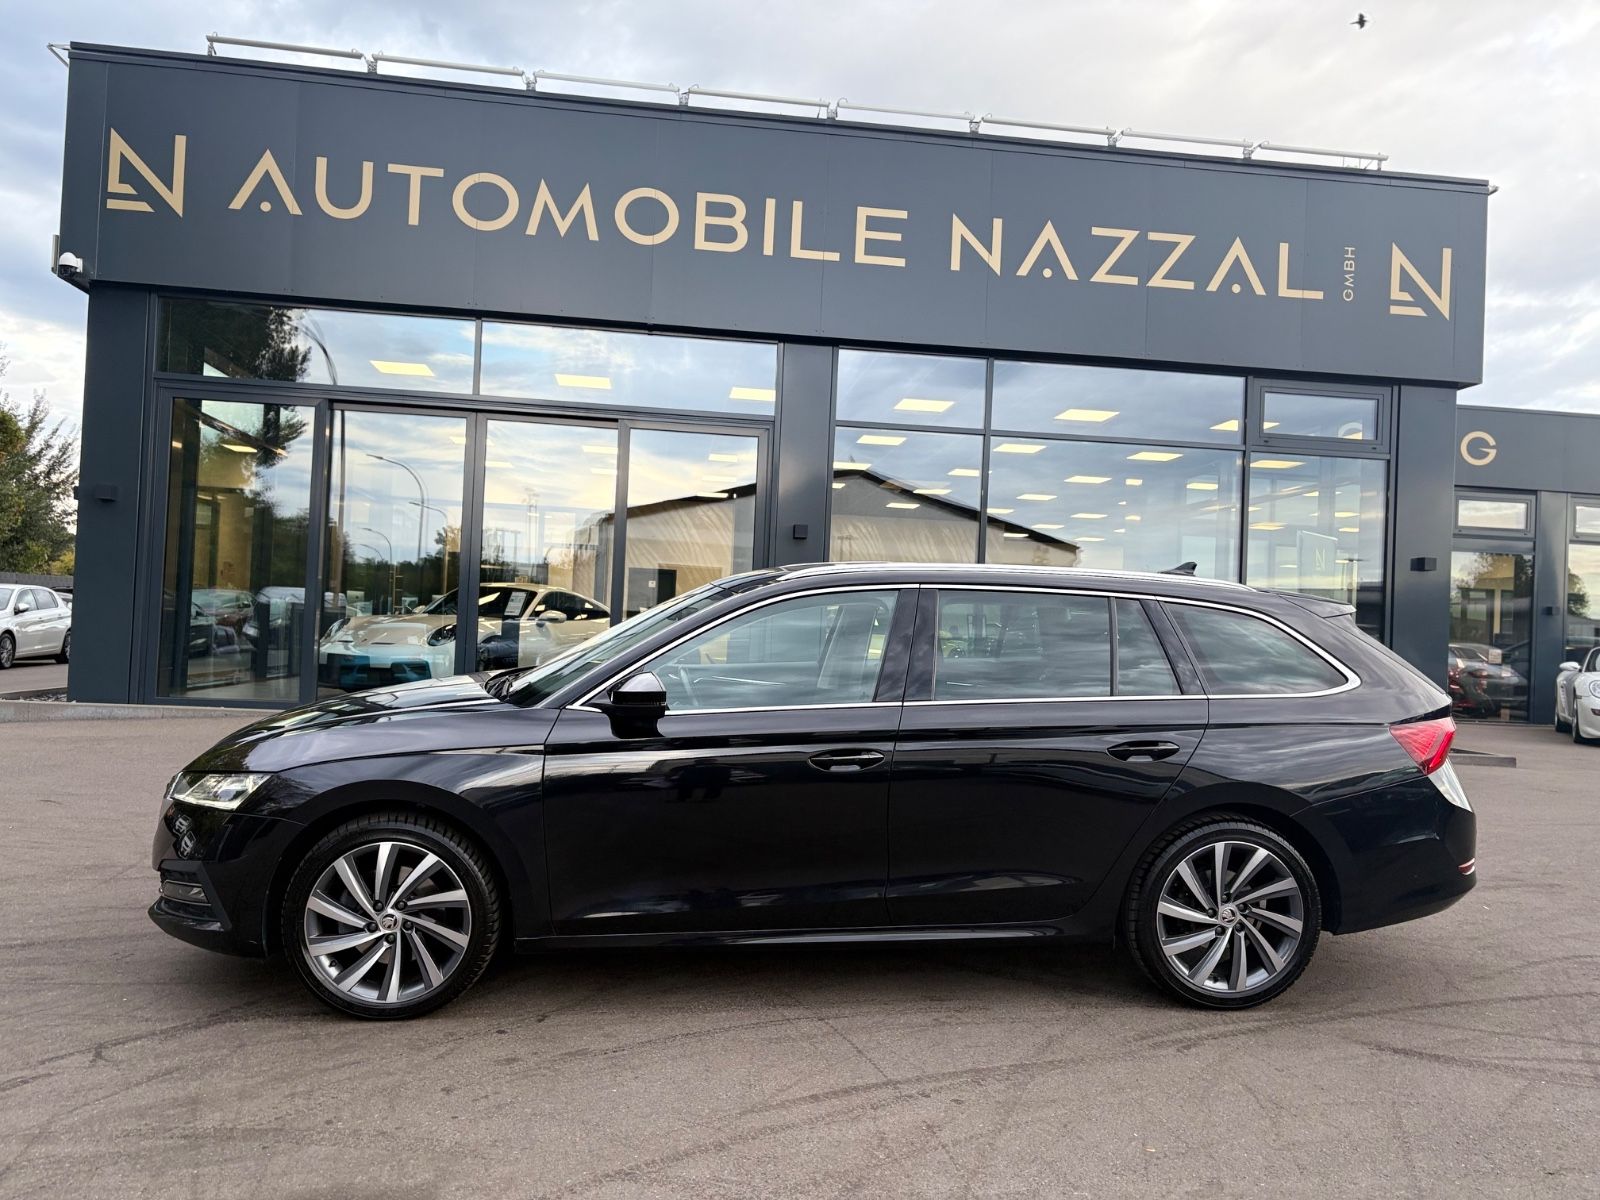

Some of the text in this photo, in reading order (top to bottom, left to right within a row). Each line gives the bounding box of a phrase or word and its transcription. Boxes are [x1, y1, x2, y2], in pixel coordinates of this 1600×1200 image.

[228, 150, 1325, 300] AUTOMOBILE NAZZAL
[1342, 246, 1356, 302] GMBH
